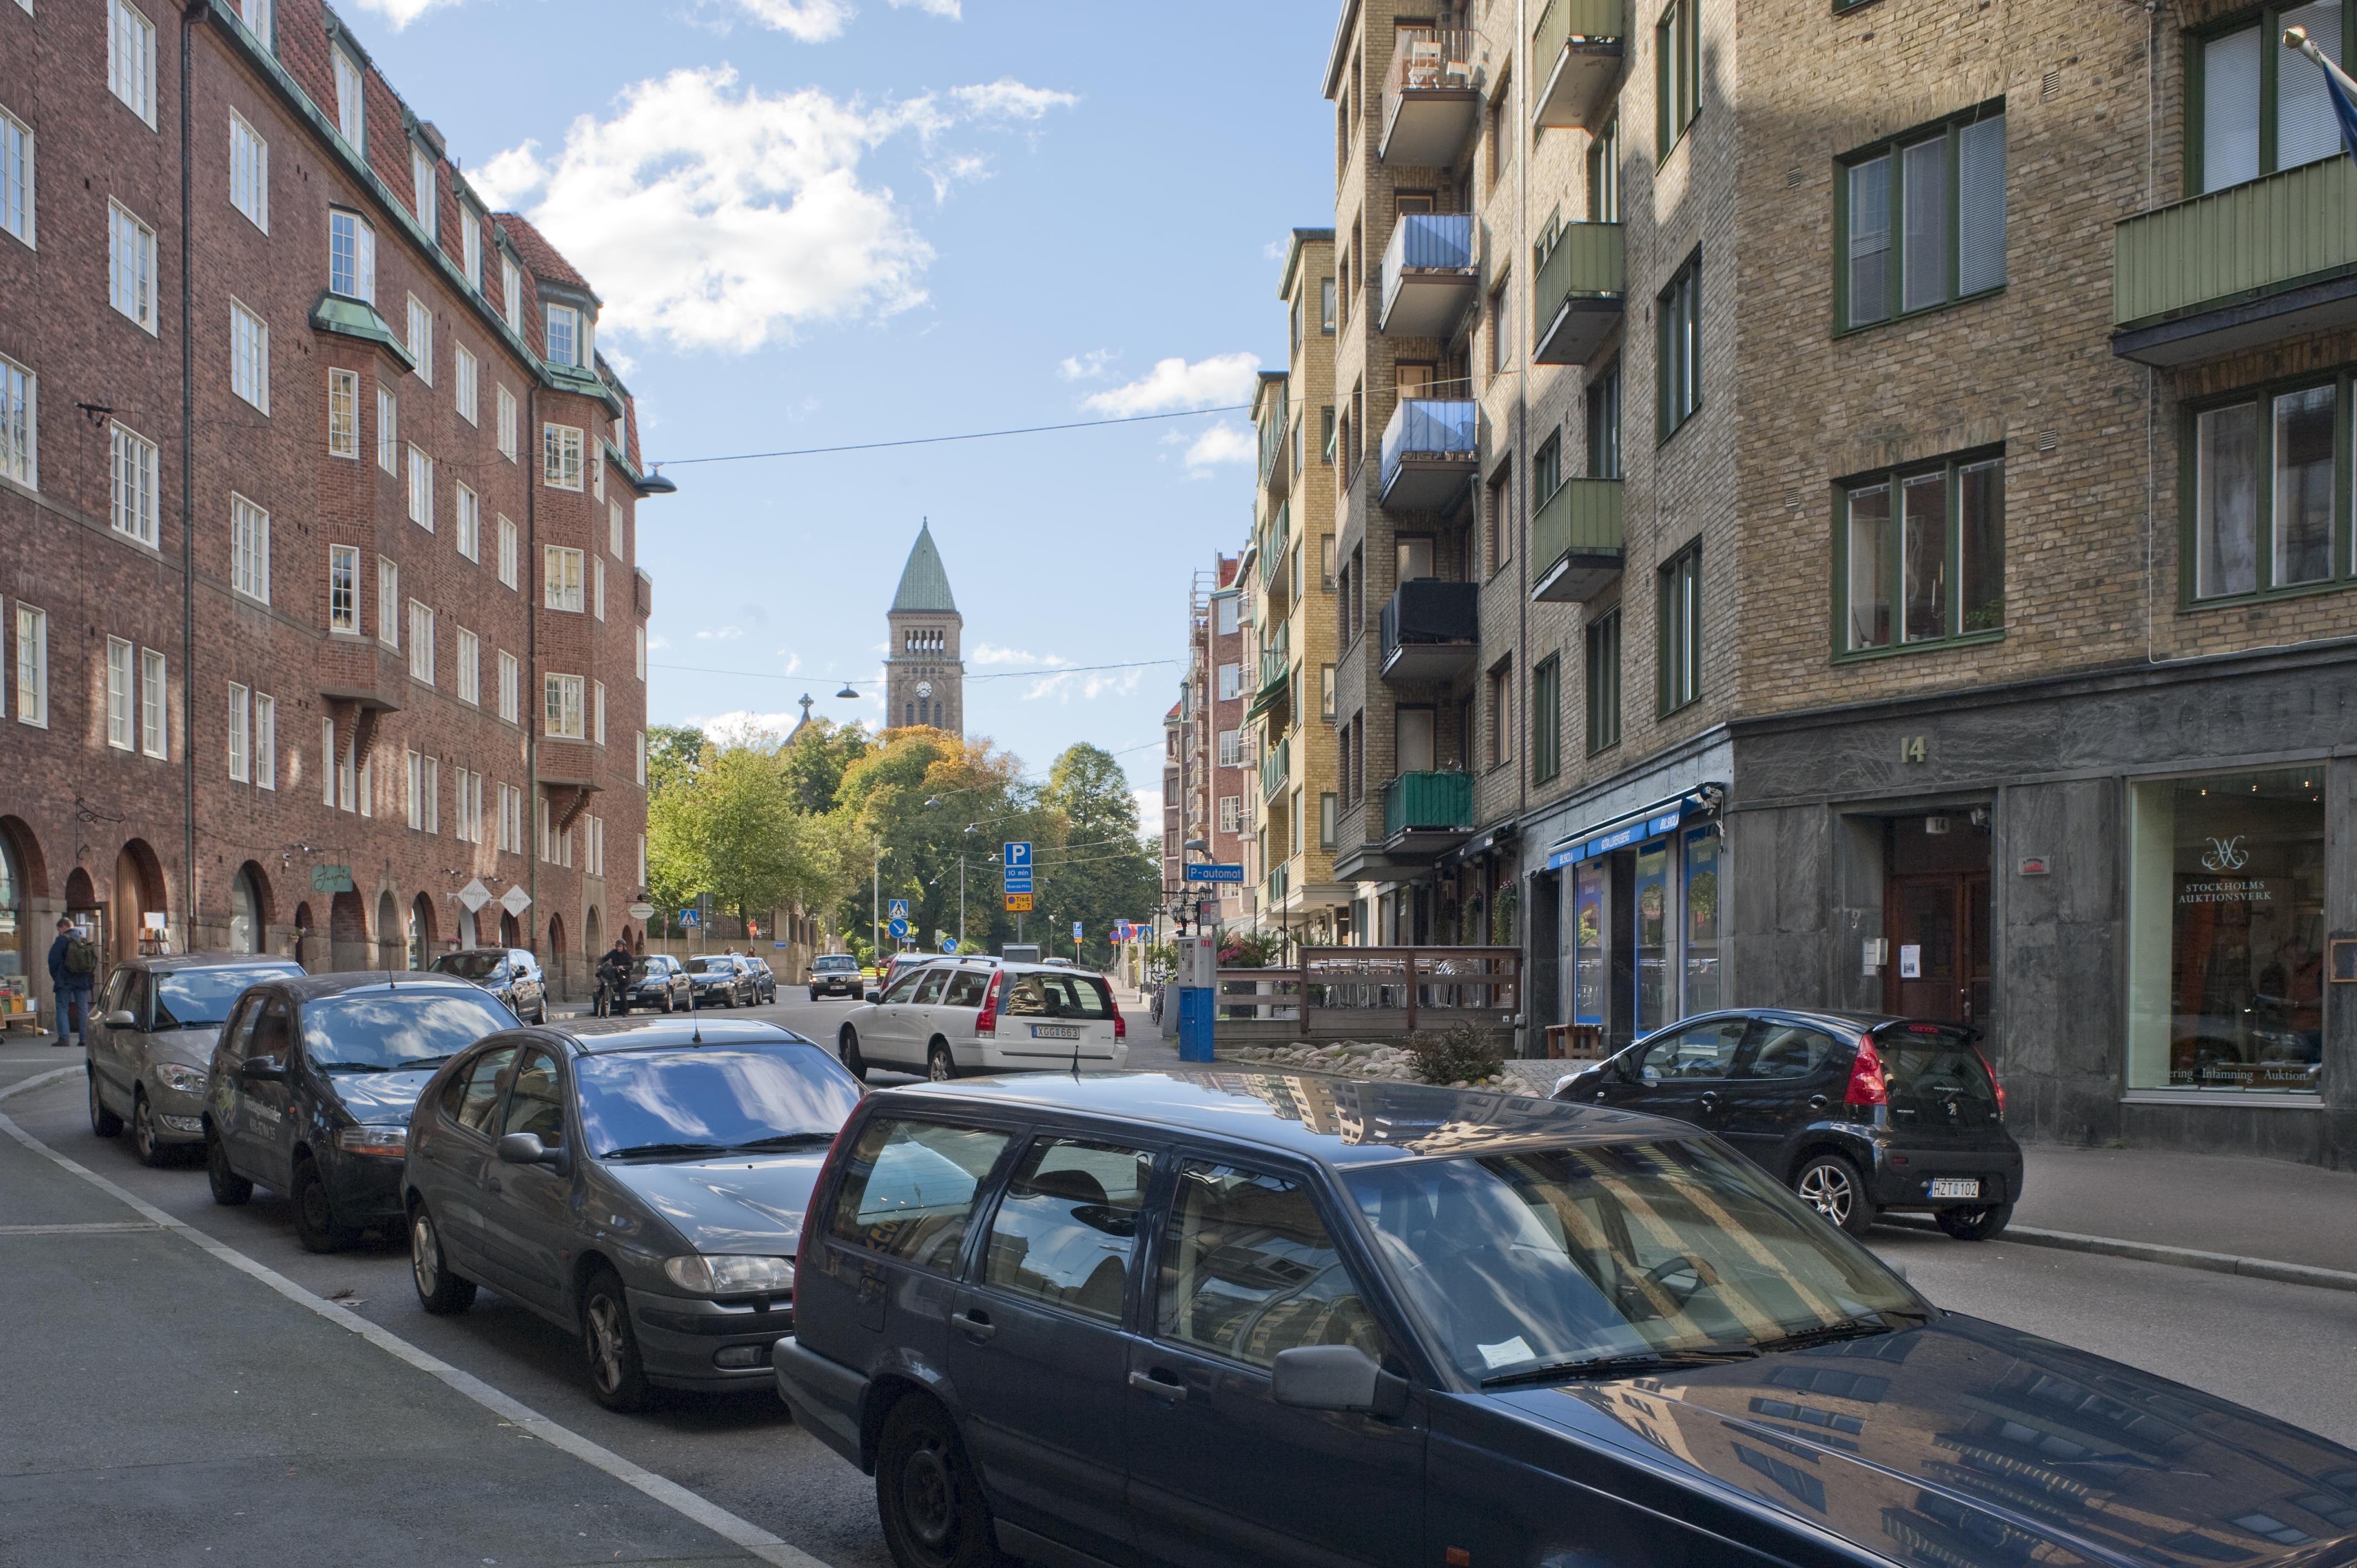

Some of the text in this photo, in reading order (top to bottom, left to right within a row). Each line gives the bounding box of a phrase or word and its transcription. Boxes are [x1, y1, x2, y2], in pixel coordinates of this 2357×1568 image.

[1901, 736, 1926, 762] 14
[1012, 845, 1026, 864] P
[314, 869, 351, 891] Jaspis
[1191, 868, 1241, 879] P-automat
[2185, 881, 2265, 893] STOCKHOLMS
[2178, 891, 2272, 904] AUKTIONSVERK
[1038, 1027, 1077, 1037] XGG 663
[2202, 1068, 2253, 1084] Inlämning
[2264, 1069, 2305, 1080] Auktion
[1934, 1182, 1977, 1196] HZT 102
